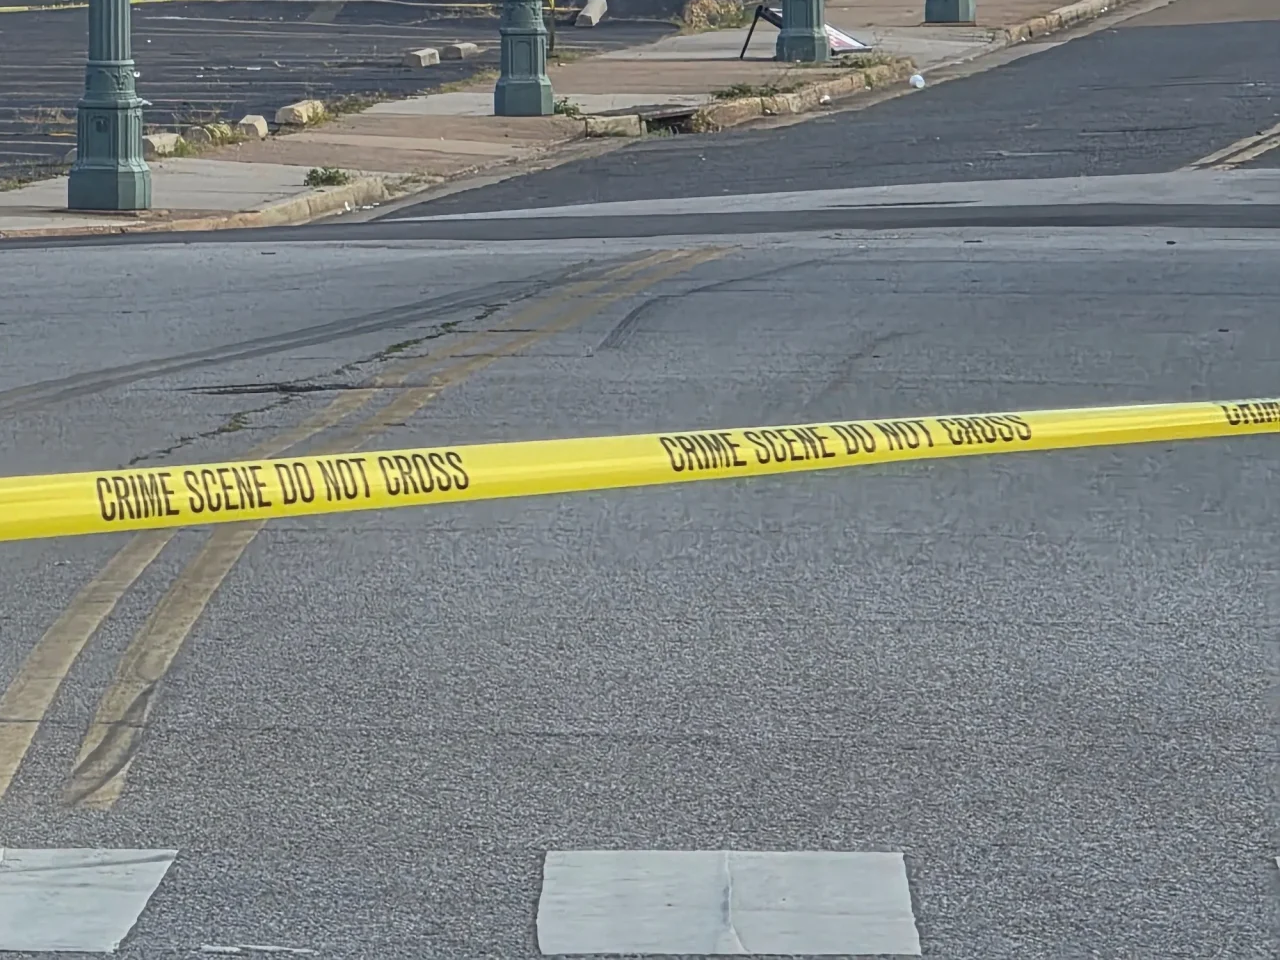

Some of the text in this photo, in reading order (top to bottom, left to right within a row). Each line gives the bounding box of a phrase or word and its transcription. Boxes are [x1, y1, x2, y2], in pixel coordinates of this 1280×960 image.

[658, 414, 1033, 472] CRIME SCENE DO NOT CROSS
[96, 451, 470, 521] CRIME SCENE DO NOT CROSS
